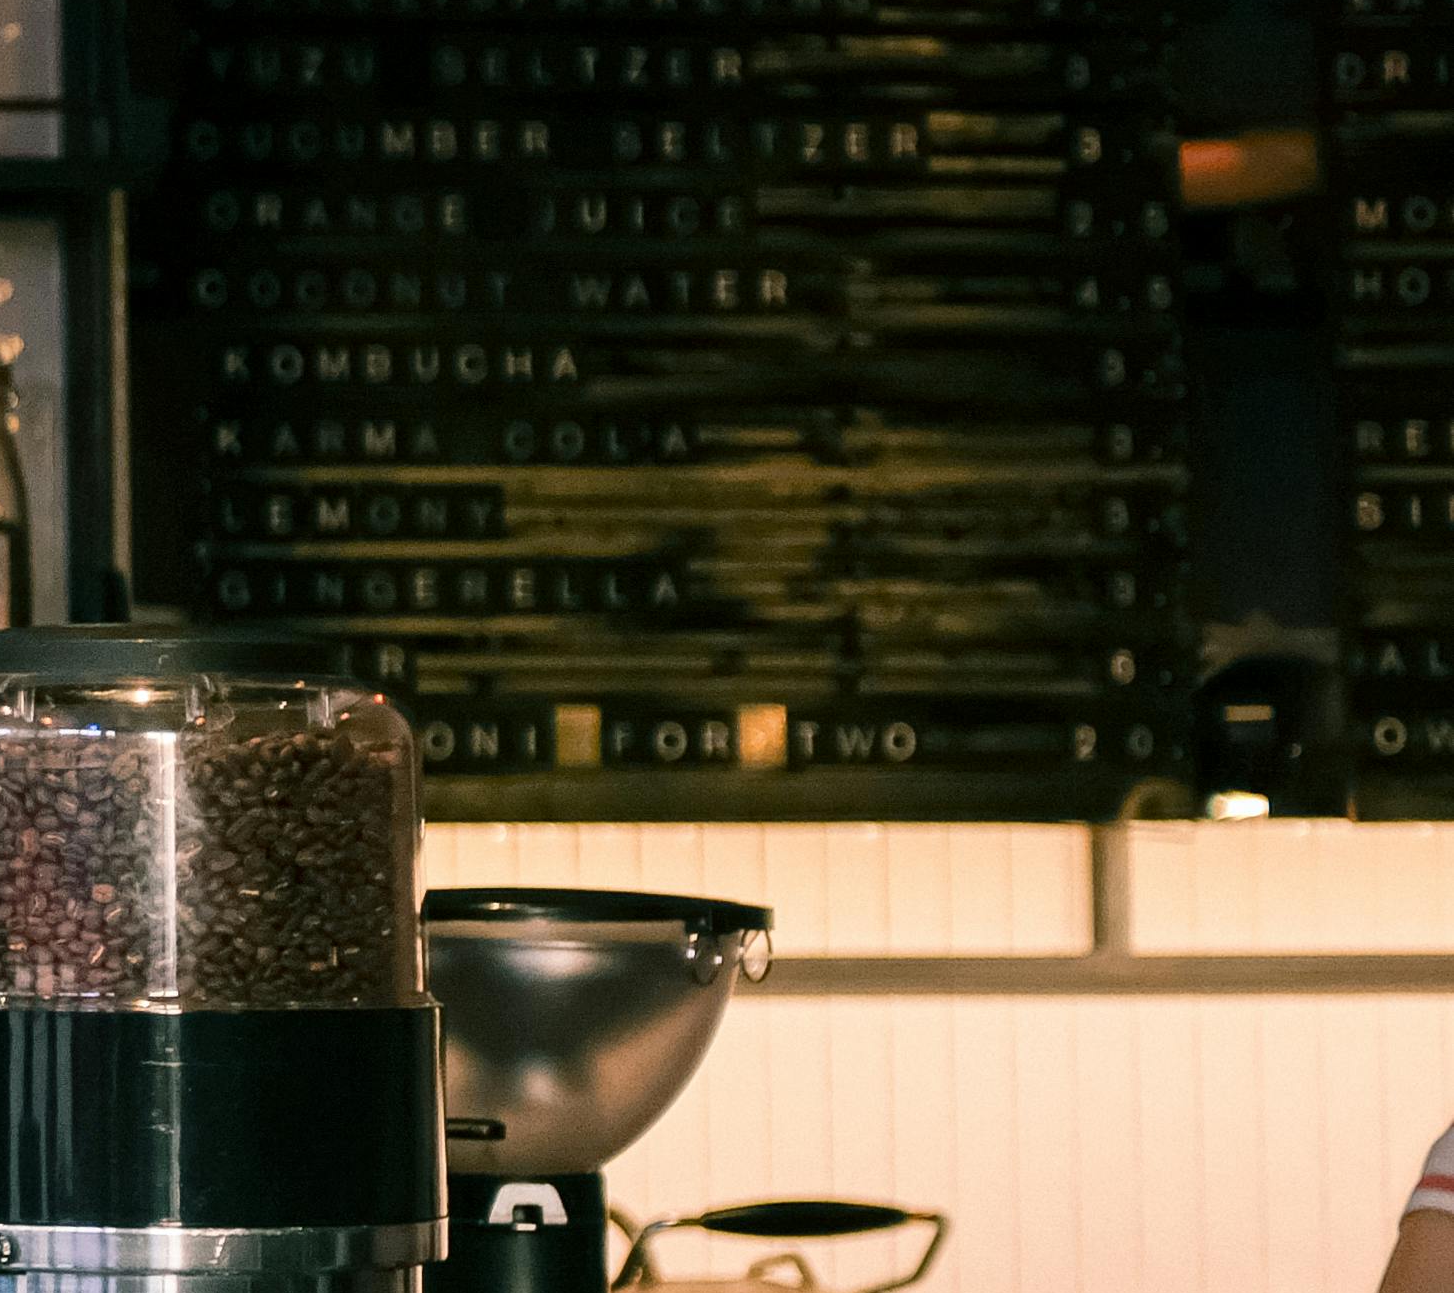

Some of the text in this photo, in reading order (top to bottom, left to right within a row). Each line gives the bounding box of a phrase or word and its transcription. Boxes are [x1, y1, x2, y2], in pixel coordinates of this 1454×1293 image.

[188, 118, 550, 161] CUCUMBER
[614, 120, 920, 163] SELTZER
[207, 190, 467, 235] ORANGE
[538, 193, 738, 235] JUICE
[1354, 194, 1454, 231] MO
[197, 267, 512, 308] COCONUT
[571, 268, 788, 308] WATER
[1354, 266, 1454, 305] HO
[224, 343, 579, 385] KOMBUCHA
[216, 420, 437, 459] KARMA
[503, 419, 689, 459] COLA
[1354, 417, 1454, 457] RE
[220, 495, 496, 535] LEMONY
[219, 570, 680, 611] GINGERELLA
[608, 720, 732, 761] FOR
[797, 719, 920, 762] TWO
